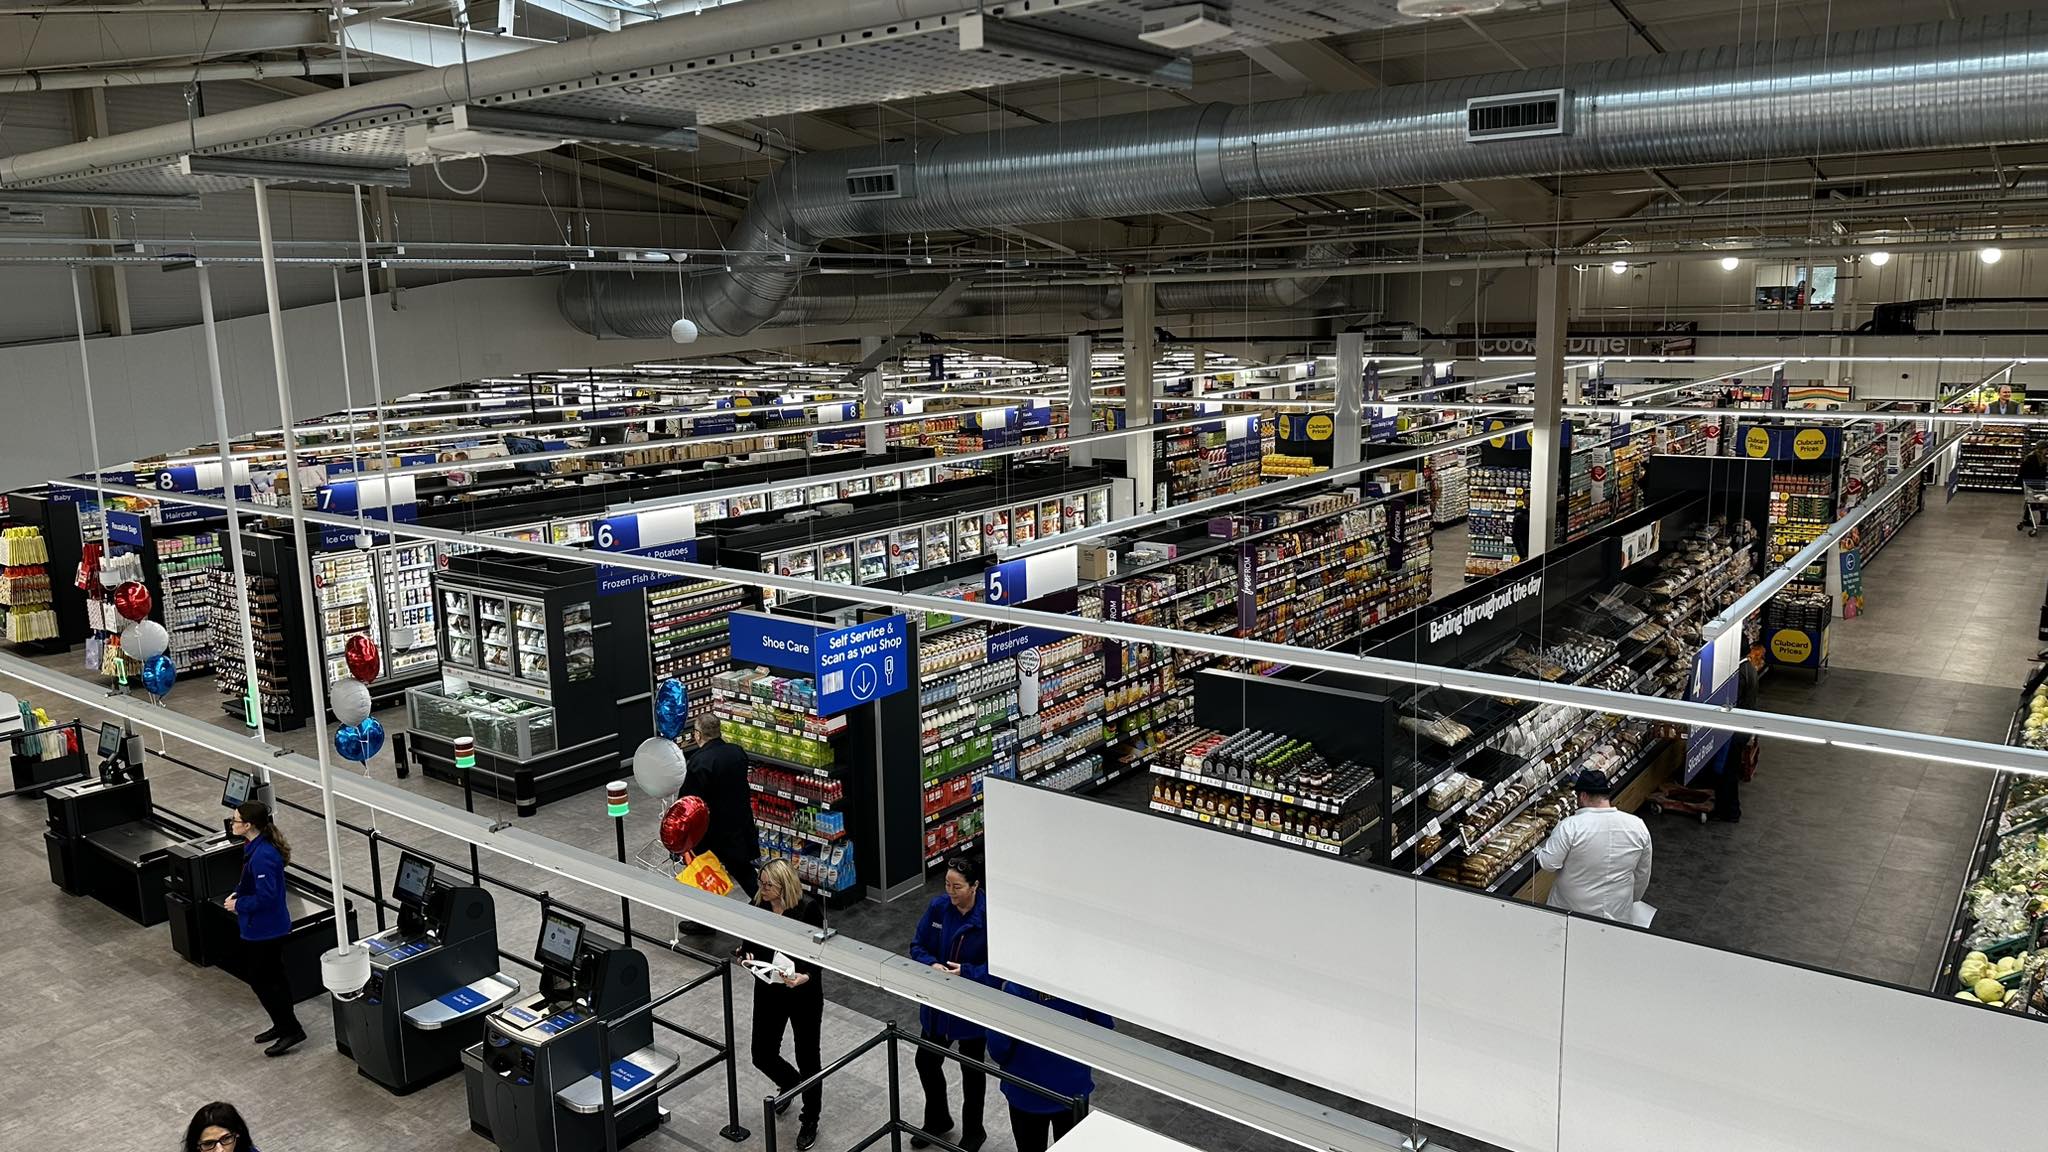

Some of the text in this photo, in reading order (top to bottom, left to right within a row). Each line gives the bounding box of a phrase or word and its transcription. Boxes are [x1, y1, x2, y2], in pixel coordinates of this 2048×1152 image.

[850, 405, 857, 418] 8
[1013, 410, 1019, 424] 7
[1252, 418, 1259, 433] 6
[1748, 436, 1768, 445] Clubcard
[1749, 443, 1764, 451] Prices
[1796, 438, 1824, 446] Clubcard
[160, 471, 174, 490] 8
[53, 494, 72, 502] Baby
[320, 488, 333, 510] 7
[165, 510, 199, 520] Haircare
[325, 536, 339, 544] Ice
[597, 523, 614, 548] 6
[654, 547, 689, 558] Potatoes
[602, 579, 631, 590] Frozen
[632, 573, 648, 584] Fish
[989, 570, 1004, 601] 5
[1430, 576, 1542, 643] Baking throughout the day
[829, 622, 894, 650] Self Service &
[762, 635, 810, 654] Shoe Care
[821, 636, 902, 667] Scan as you Shop
[991, 635, 1029, 653] Preserves
[1774, 639, 1809, 649] Clubcard
[1779, 647, 1802, 656] Prices
[1693, 658, 1702, 699] 4
